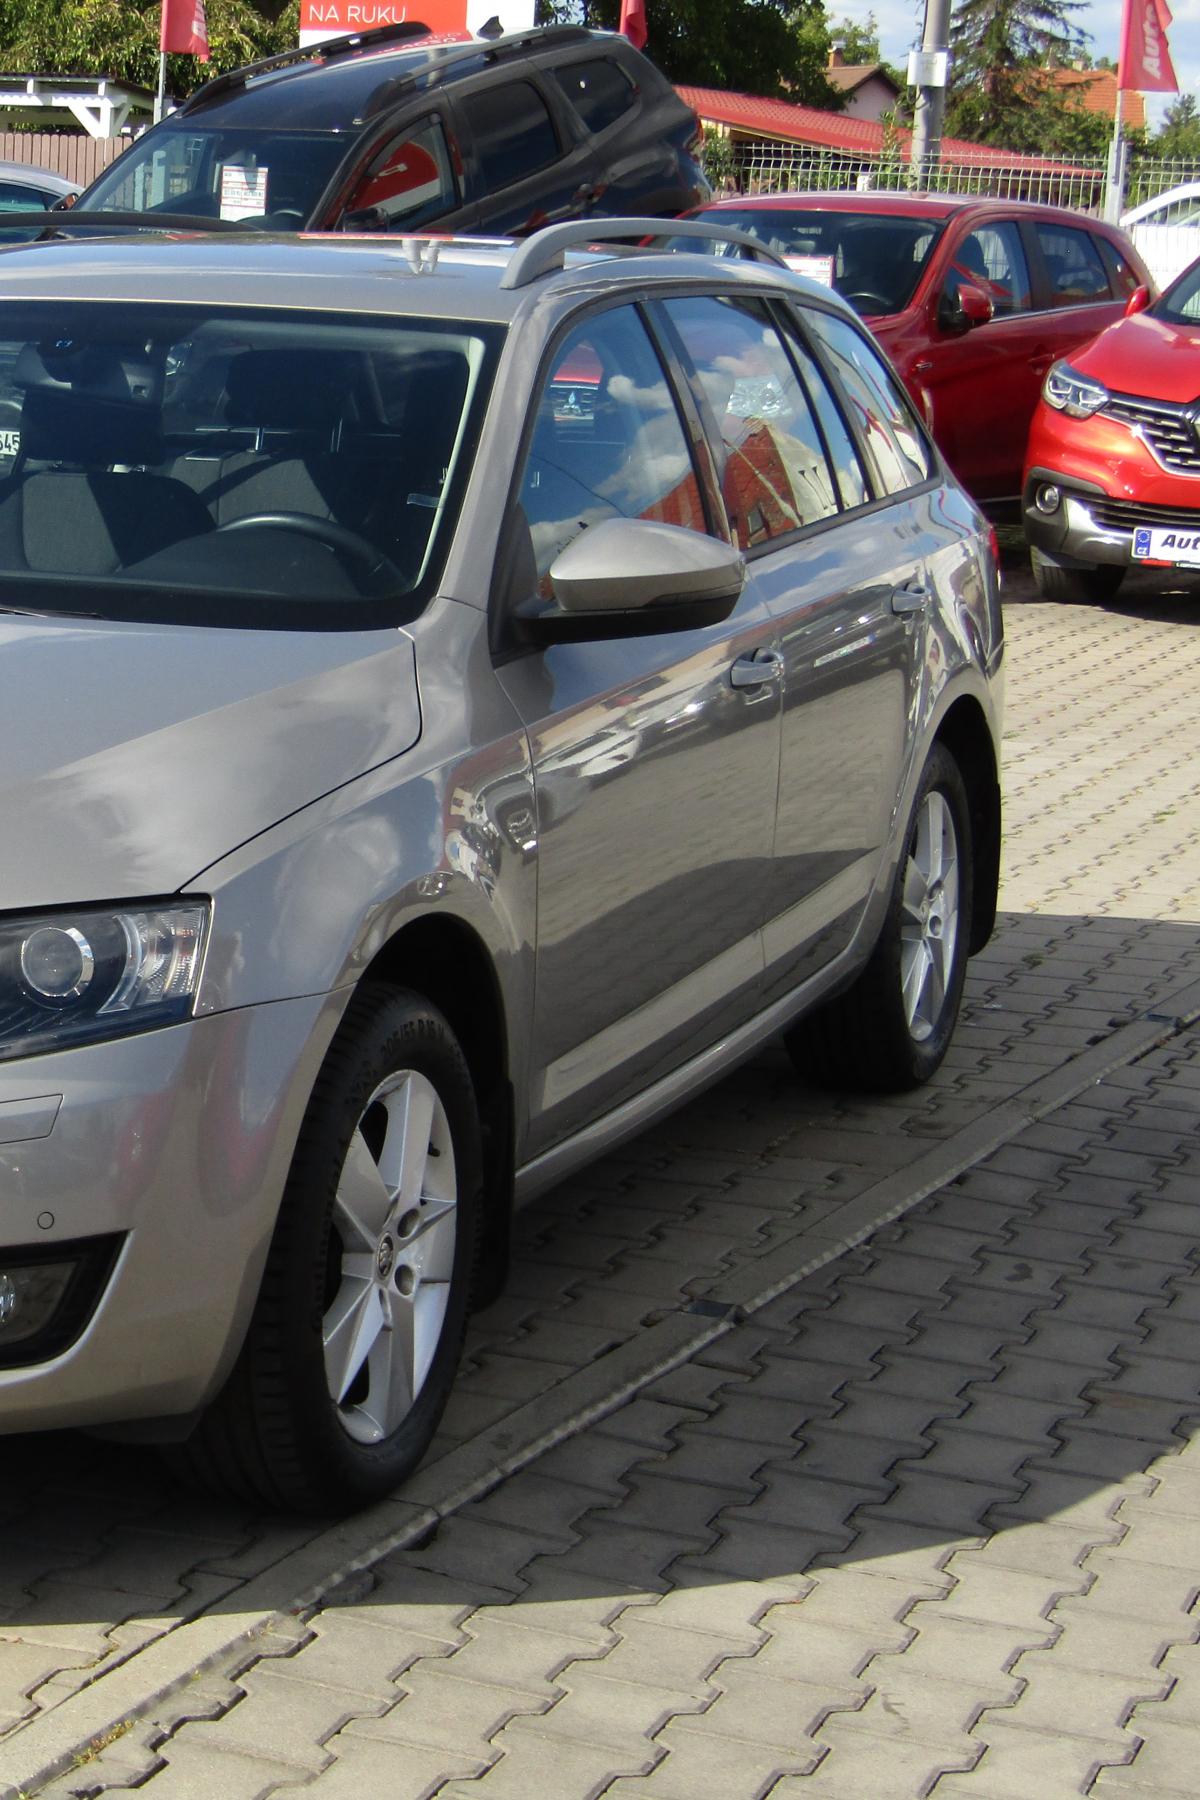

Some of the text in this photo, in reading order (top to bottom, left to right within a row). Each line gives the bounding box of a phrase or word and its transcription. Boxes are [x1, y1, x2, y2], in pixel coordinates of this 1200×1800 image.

[308, 5, 406, 24] NA RUKU
[1136, 546, 1148, 555] CZ
